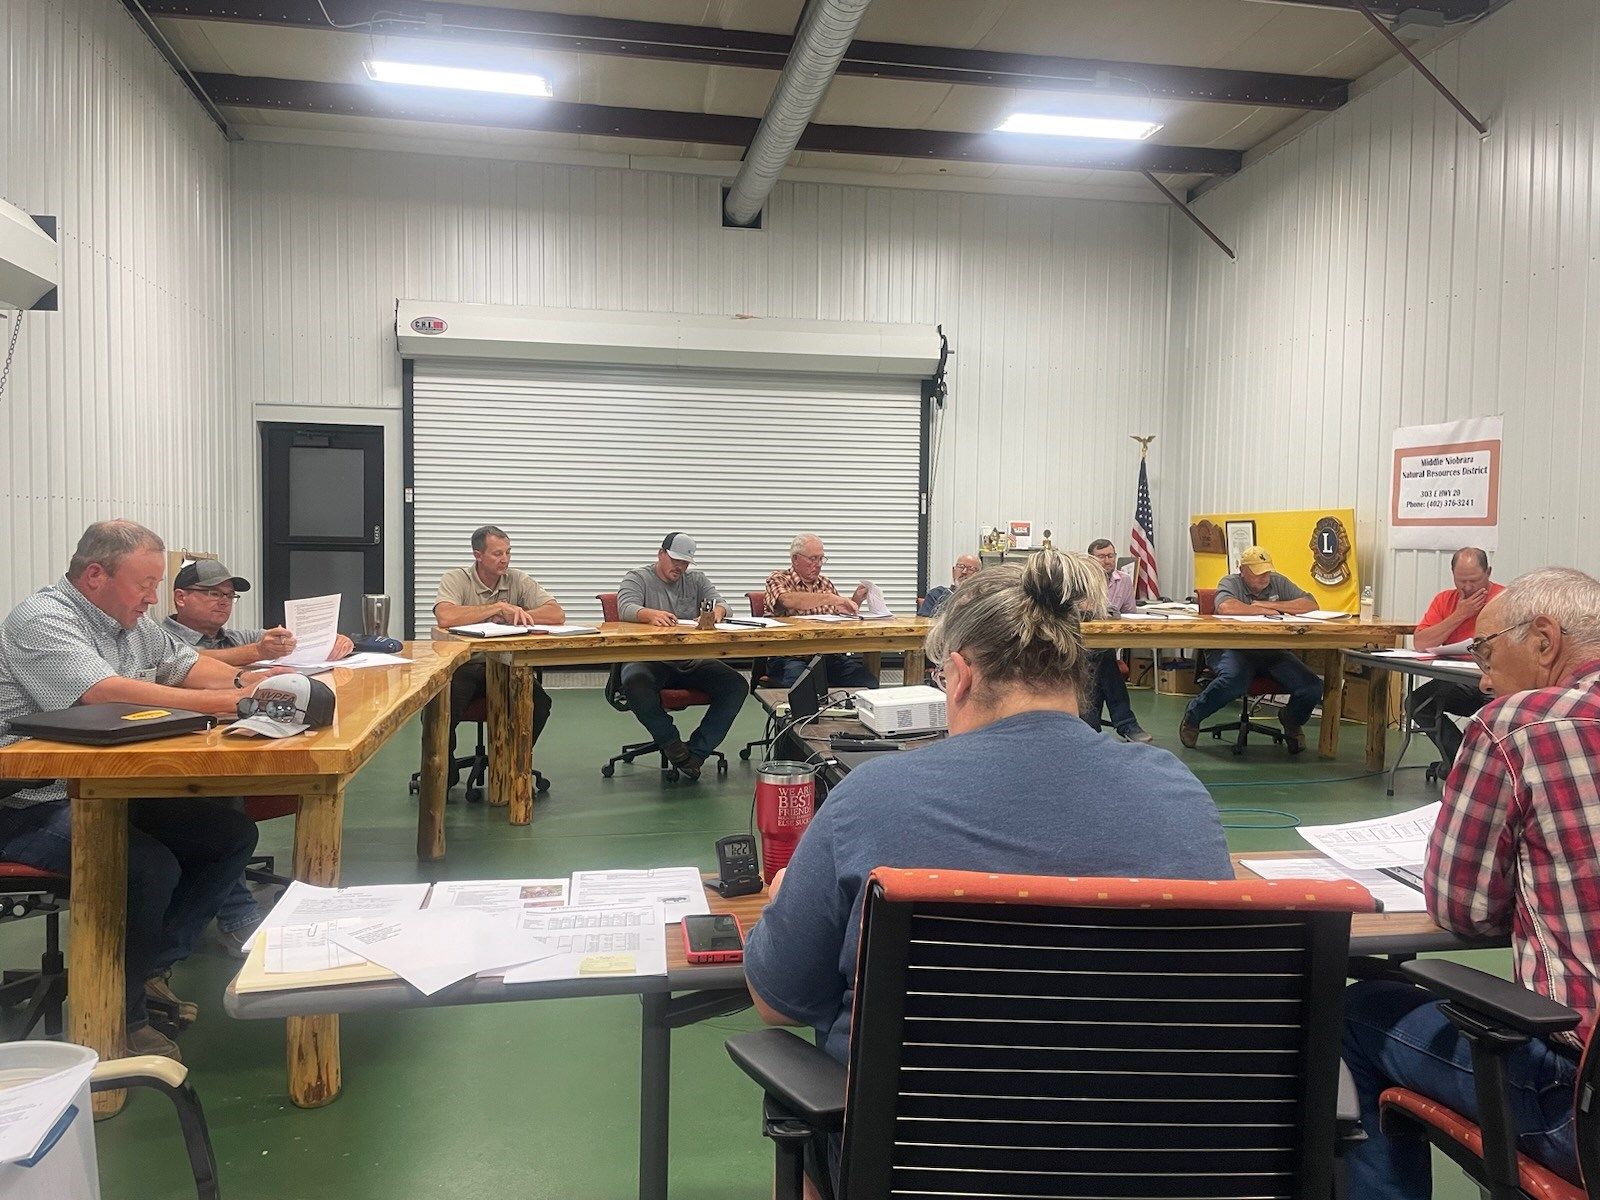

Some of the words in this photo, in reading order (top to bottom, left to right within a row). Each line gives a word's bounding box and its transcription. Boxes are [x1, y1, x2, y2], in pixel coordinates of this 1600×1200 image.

[1421, 458, 1443, 466] Middle
[1445, 456, 1474, 465] Niobrara
[1402, 470, 1425, 478] Natural
[1426, 469, 1460, 478] Resources
[1462, 466, 1488, 475] District
[1420, 490, 1432, 498] 303
[1438, 489, 1451, 497] HWY
[1426, 500, 1443, 508] (402)
[1444, 499, 1474, 507] 376-3241
[1322, 532, 1333, 553] L
[778, 787, 796, 796] WE
[778, 793, 812, 808] BEST
